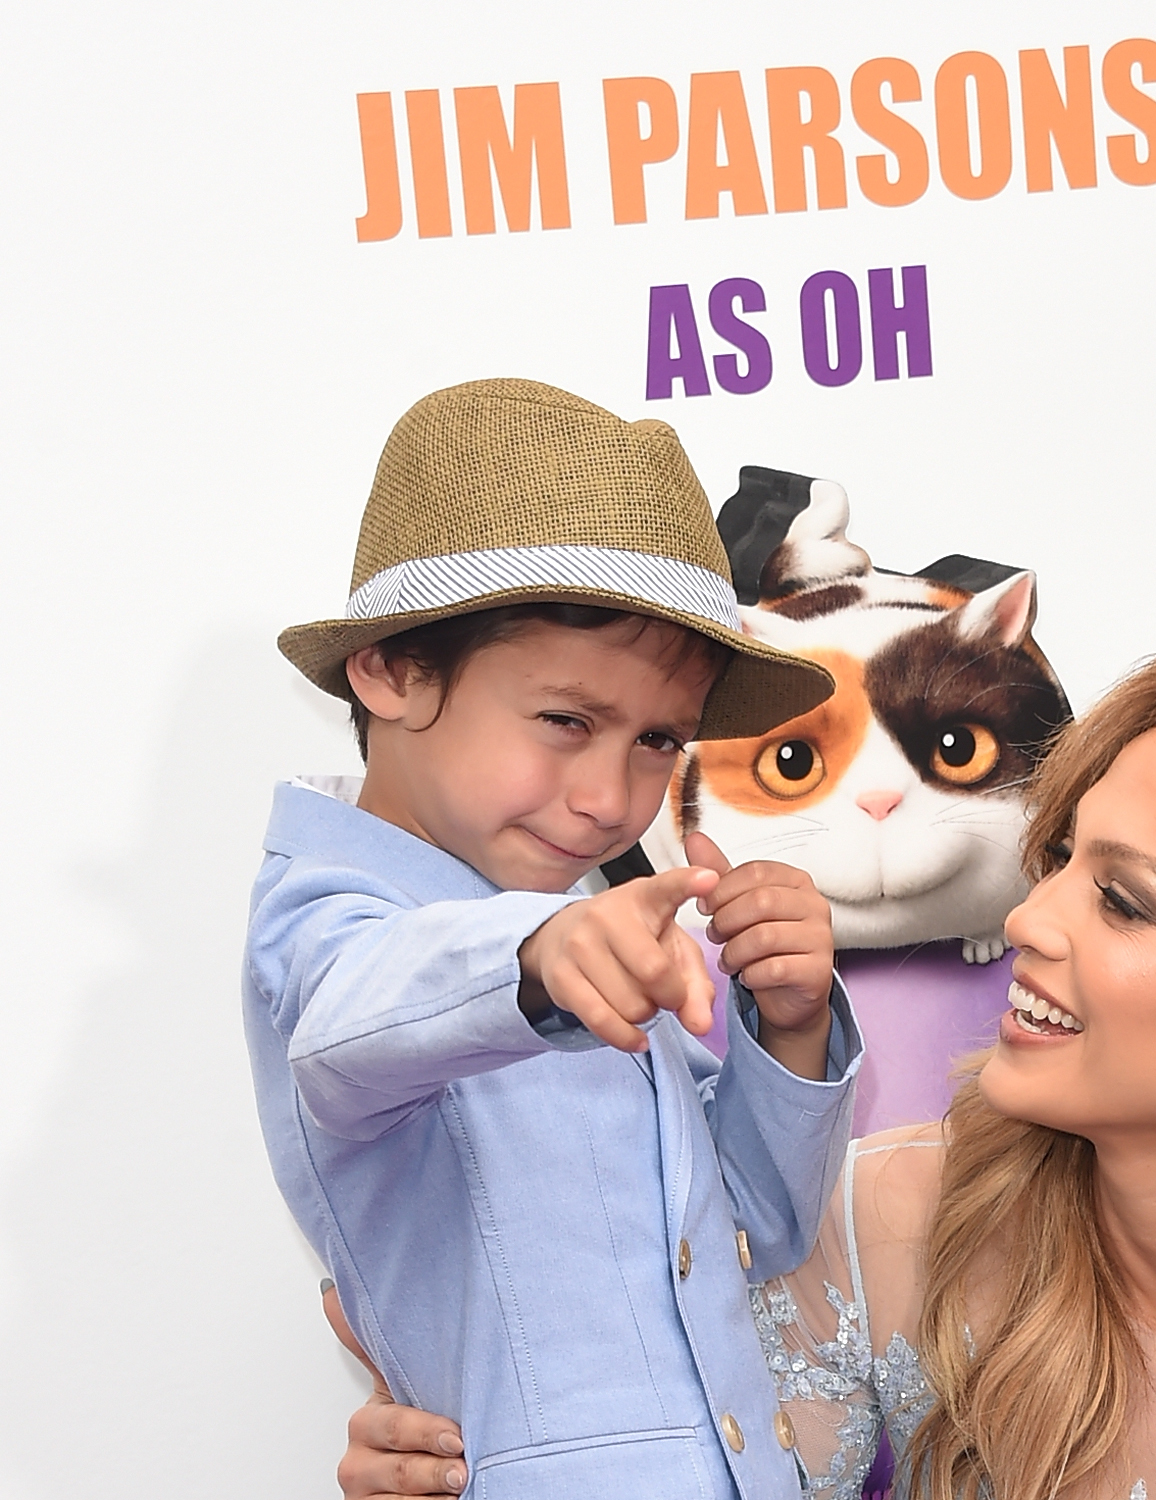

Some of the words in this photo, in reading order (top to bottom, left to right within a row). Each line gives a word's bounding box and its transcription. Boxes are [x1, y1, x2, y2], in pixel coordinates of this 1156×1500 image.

[355, 81, 572, 243] JIM
[645, 277, 774, 401] AS
[799, 265, 934, 388] OH
